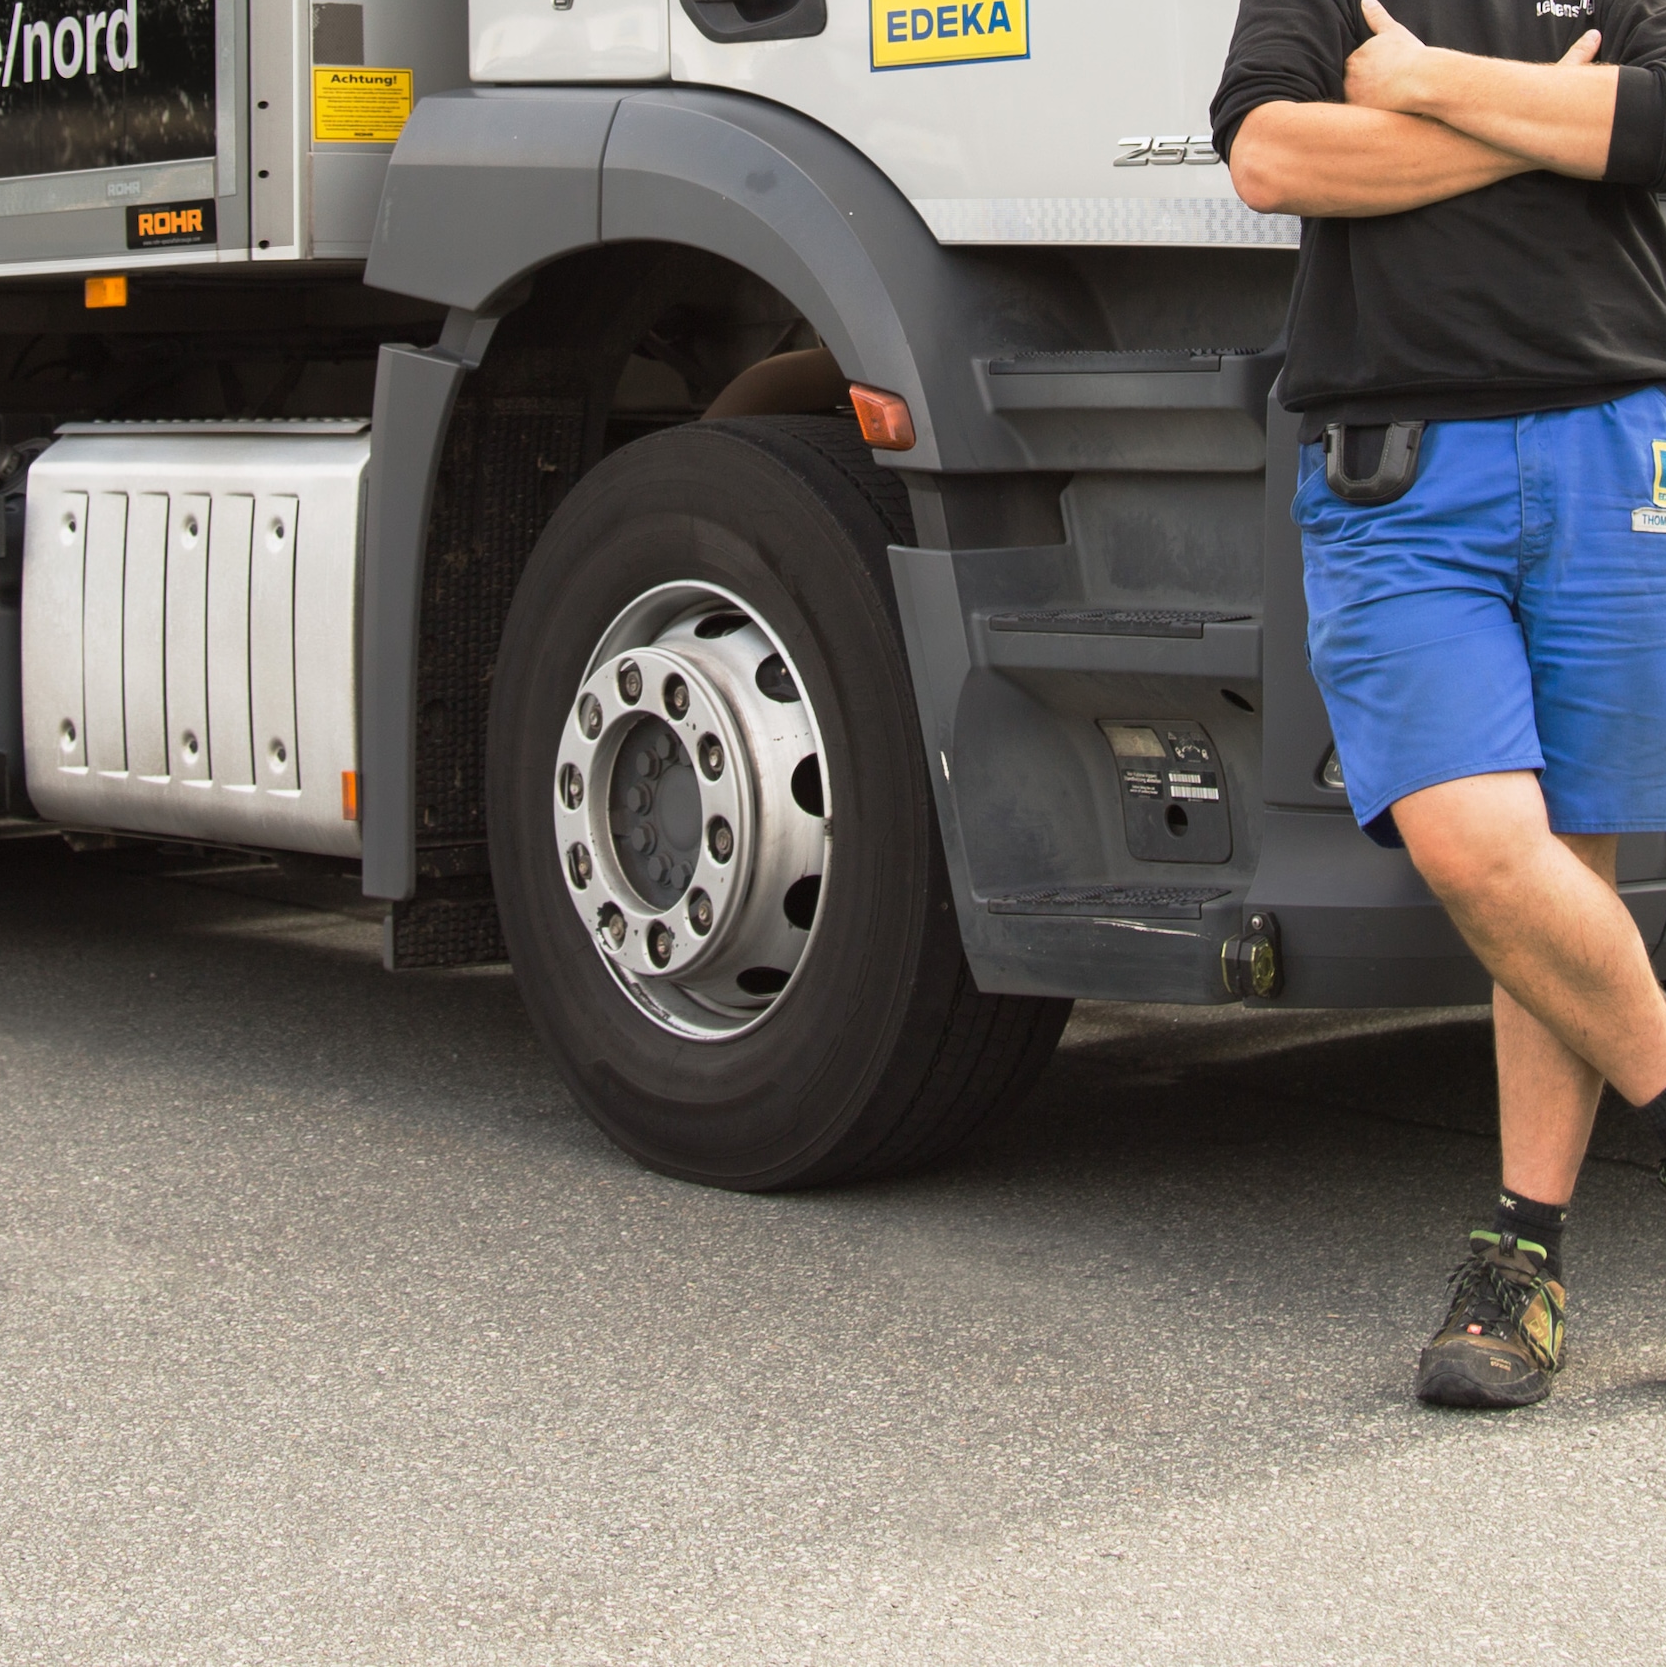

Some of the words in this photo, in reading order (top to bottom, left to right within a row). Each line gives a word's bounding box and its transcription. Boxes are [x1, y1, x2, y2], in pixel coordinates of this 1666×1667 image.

[885, 0, 1012, 44] EDEKA
[331, 74, 398, 87] Achtung!
[107, 181, 141, 197] ROHR
[138, 208, 203, 237] ROHR
